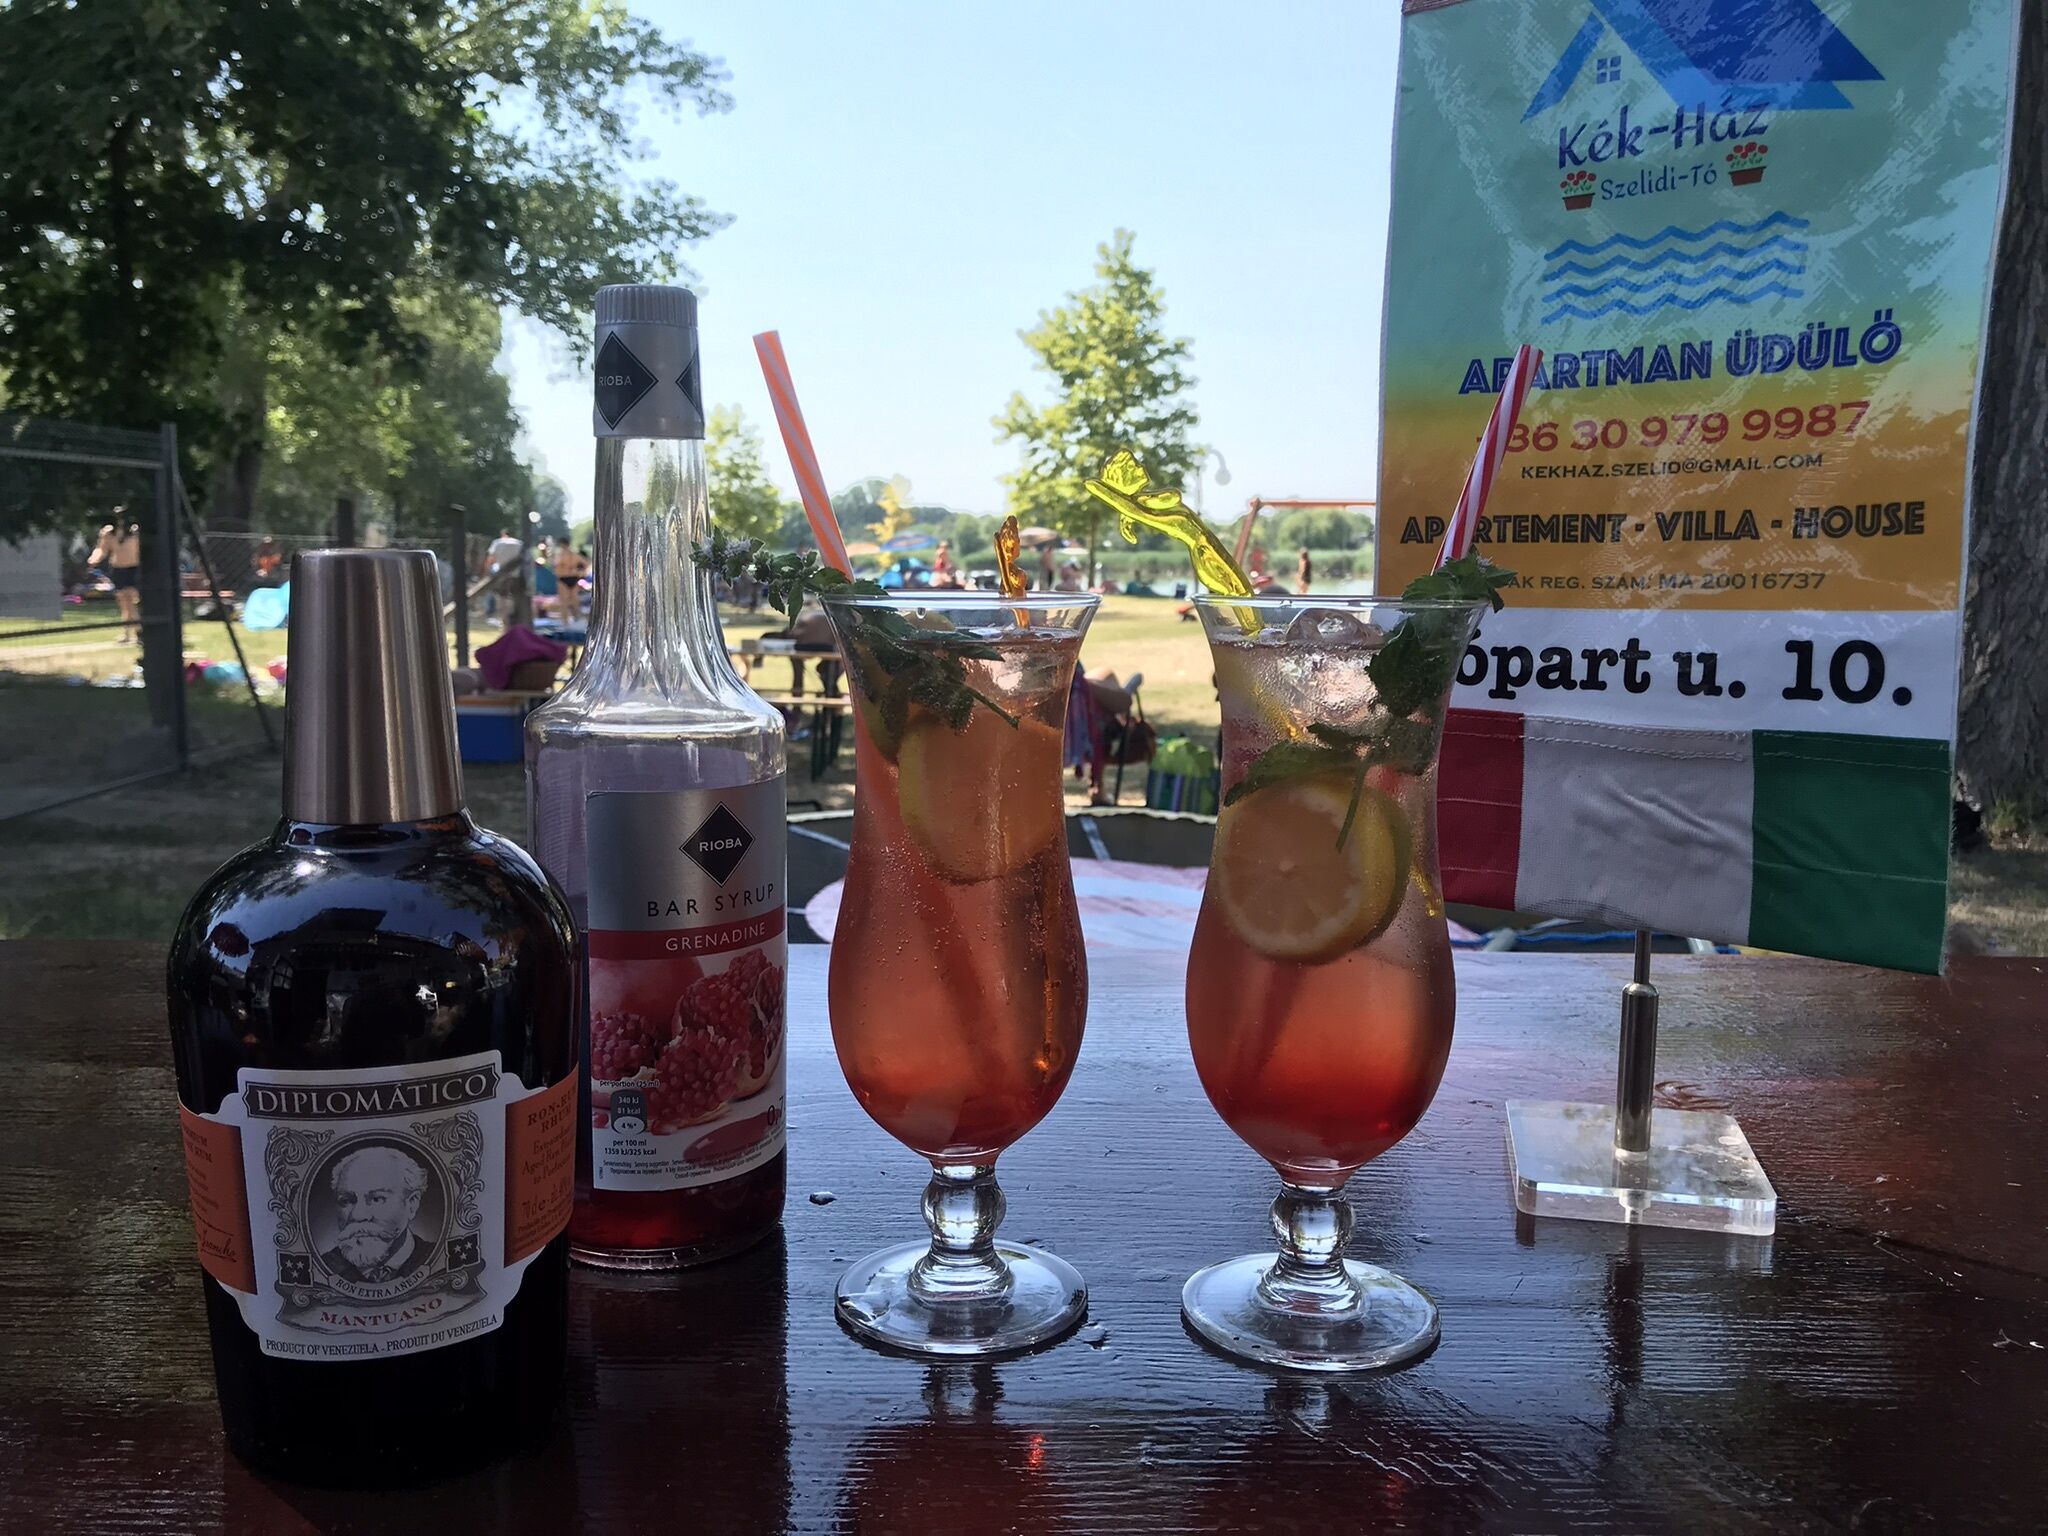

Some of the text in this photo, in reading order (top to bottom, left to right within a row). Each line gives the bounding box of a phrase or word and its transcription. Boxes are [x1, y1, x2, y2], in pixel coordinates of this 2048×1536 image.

[1558, 94, 1770, 169] Kék-Ház
[1601, 163, 1717, 200] Szelidi-Tó
[598, 375, 633, 387] RIOBA
[1475, 401, 1871, 454] 36 30 979 9987
[1521, 454, 1824, 480] KEKHAZ.SZELID@GMAIL.COM
[1400, 501, 1926, 545] APRTEMENT VILLA HOUSE
[1540, 576, 1585, 590] REG.
[1658, 573, 1693, 590] MA
[1701, 573, 1827, 590] 20016737
[1455, 628, 1914, 706] ópart u. 10.
[699, 837, 743, 852] RIOBA
[647, 883, 775, 918] BAR SYRUP
[665, 921, 766, 951] GRENADINE
[256, 1072, 488, 1114] DIPLOMÁTICO
[625, 1139, 638, 1147] 100
[638, 1139, 647, 1147] ml
[643, 1147, 657, 1155] kcal
[335, 1278, 357, 1293] RON
[357, 1286, 392, 1299] EXTRA
[320, 1298, 443, 1327] MANTUANO
[266, 1314, 498, 1356] PRODUCT OF VENEZUELA PRODUIT DU VENEZUELA
